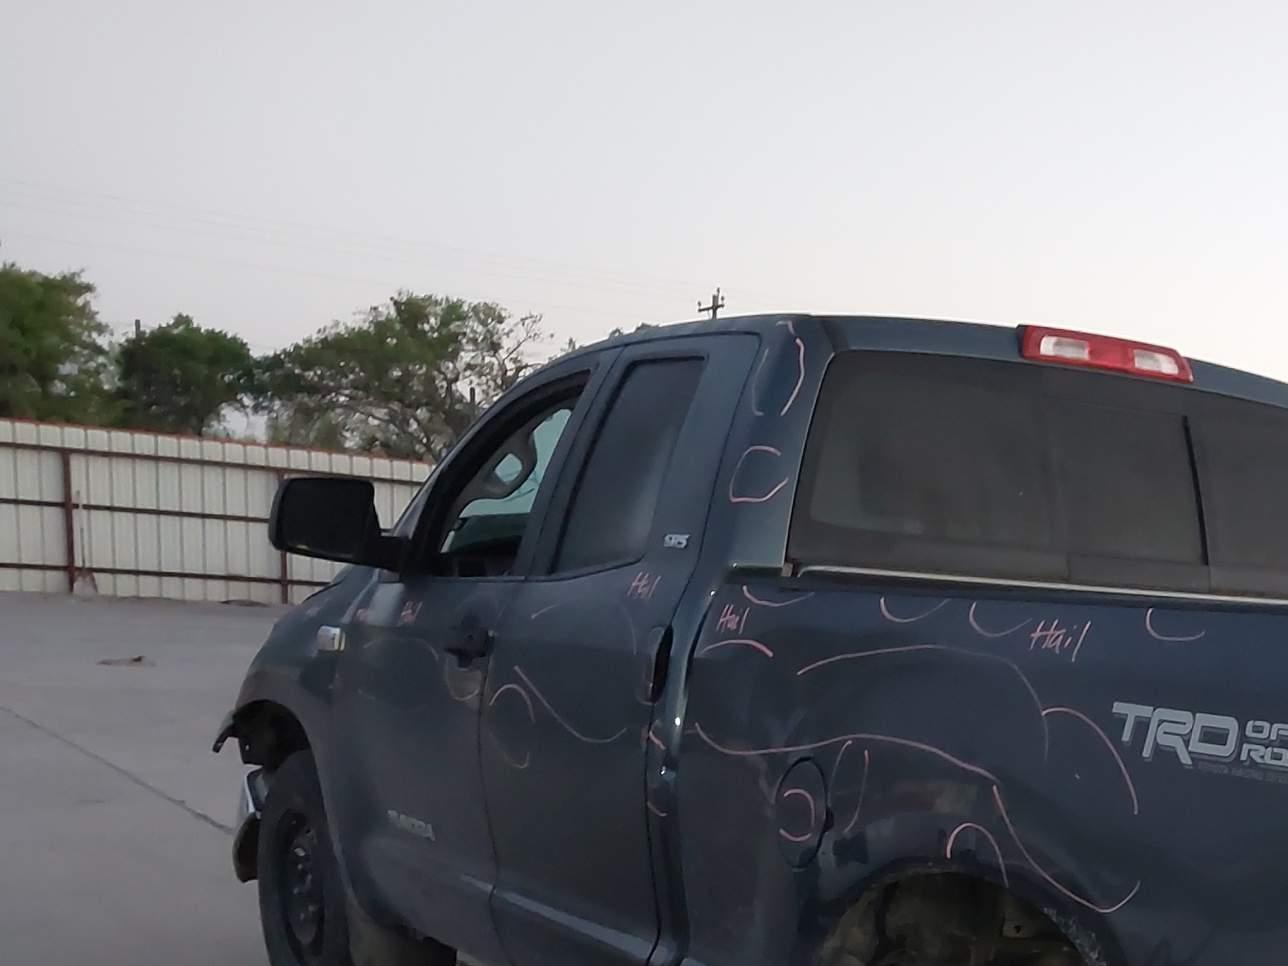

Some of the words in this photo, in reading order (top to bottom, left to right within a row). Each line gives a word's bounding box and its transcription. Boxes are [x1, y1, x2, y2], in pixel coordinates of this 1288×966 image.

[715, 603, 750, 635] Hail
[1029, 618, 1092, 662] Hail
[1111, 701, 1240, 768] TRD
